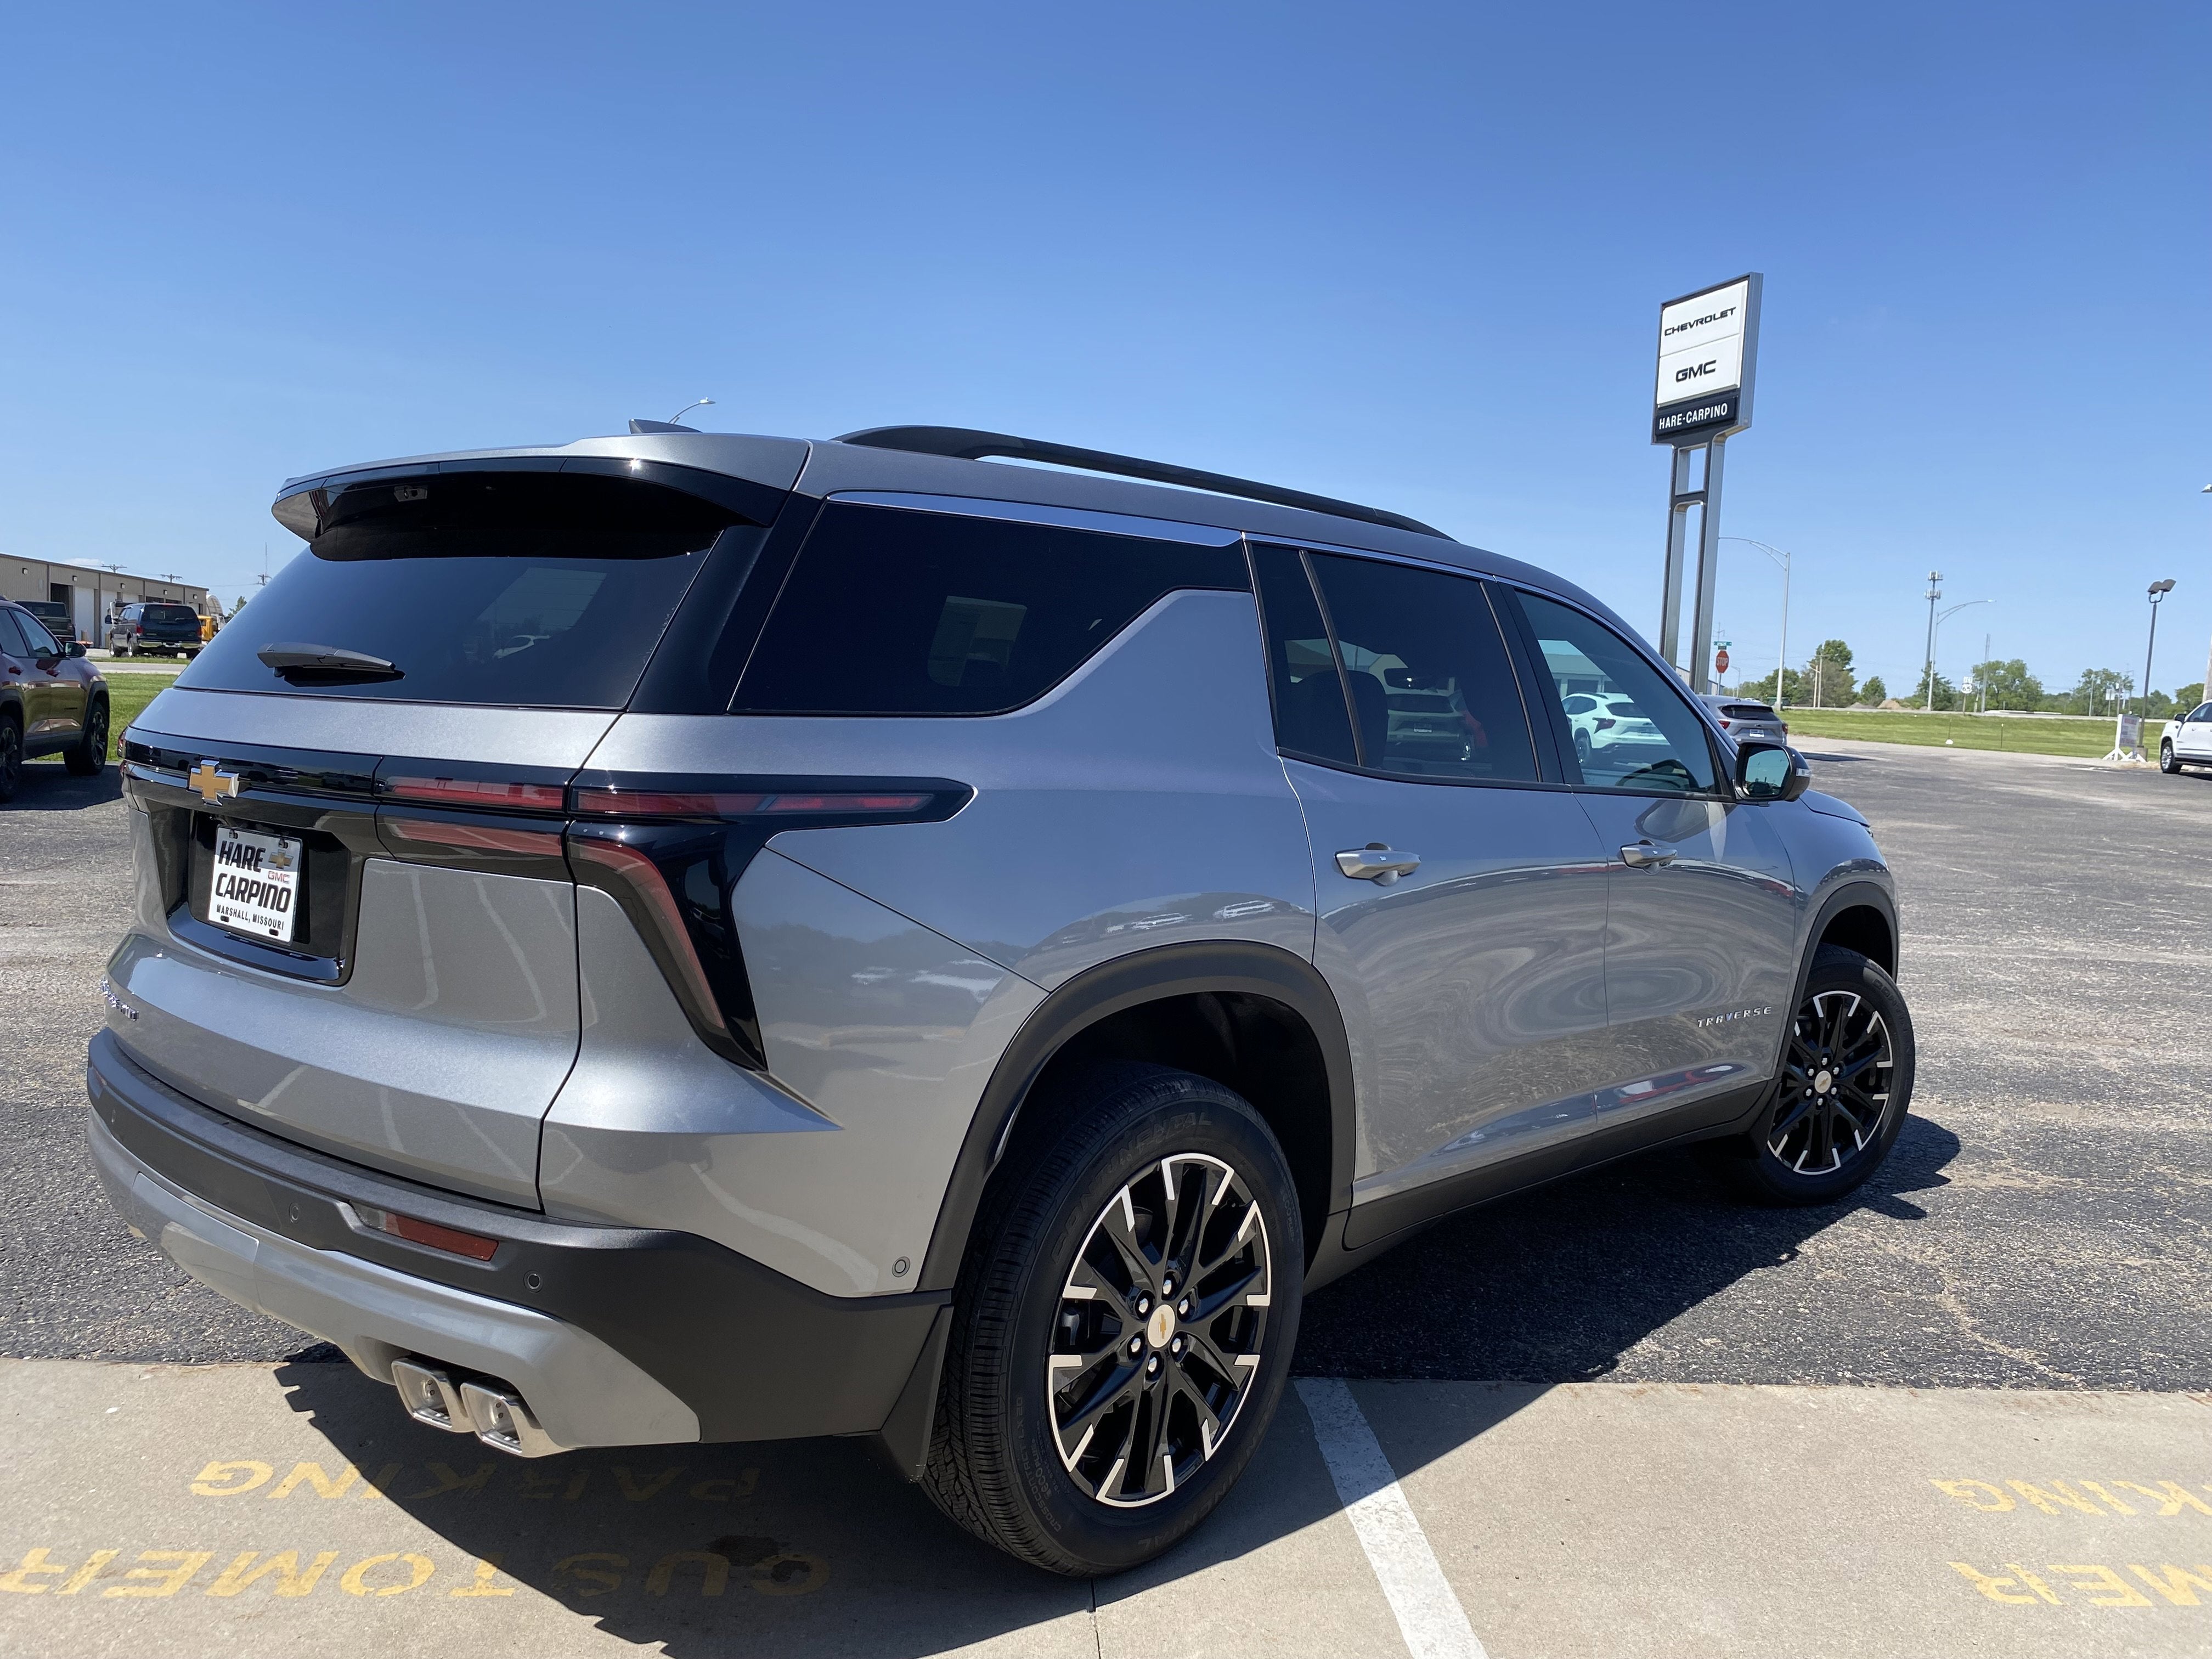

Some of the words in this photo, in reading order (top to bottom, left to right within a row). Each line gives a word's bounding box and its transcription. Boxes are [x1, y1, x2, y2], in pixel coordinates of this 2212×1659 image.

[1664, 307, 1736, 336] CHEVROLET
[1675, 359, 1716, 382] GMC
[1659, 403, 1728, 430] HARE-CARPINO
[1717, 657, 1728, 666] STOP
[218, 840, 266, 873] HARE
[268, 871, 290, 883] GMC
[215, 872, 292, 913] CARPINO
[216, 904, 251, 923] MARSHALL,
[252, 913, 284, 930] MISSOURI
[1697, 1006, 1772, 1028] TRAVERSE
[190, 1460, 760, 1502] PARKING
[1928, 1478, 2212, 1516] KING
[0, 1548, 831, 1598] CUSTOMER
